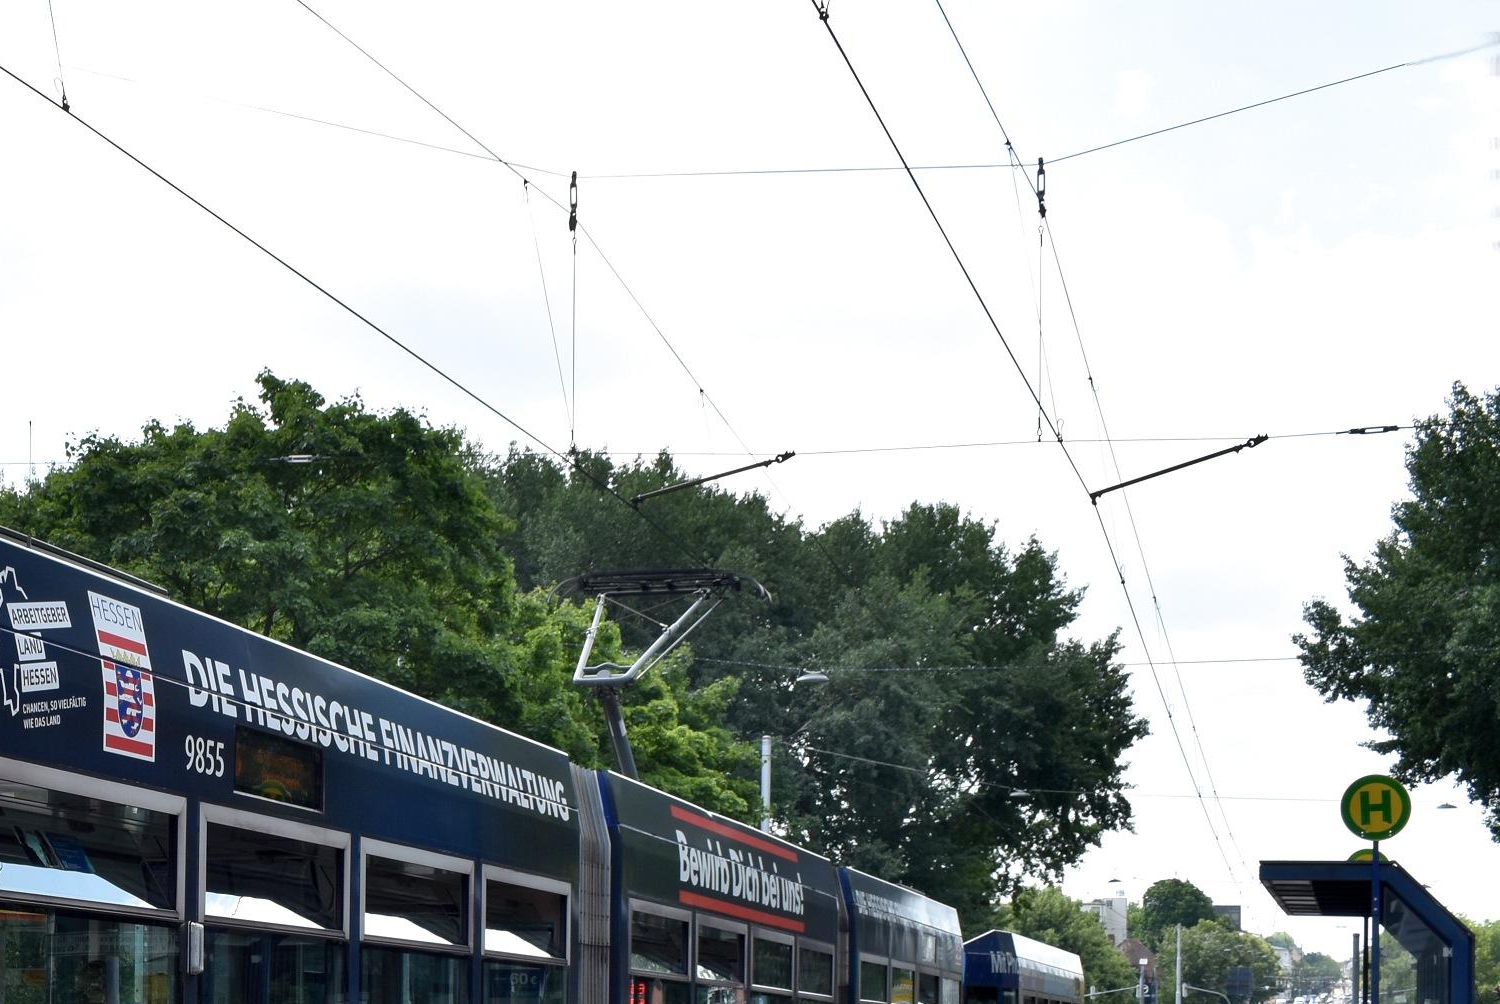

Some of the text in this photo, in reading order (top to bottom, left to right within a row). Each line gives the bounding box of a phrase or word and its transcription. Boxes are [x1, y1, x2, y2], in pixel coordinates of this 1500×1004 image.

[11, 606, 68, 625] ARBEITGEBER
[92, 600, 142, 632] HESSEN
[17, 637, 43, 655] LAND
[23, 667, 57, 687] HESSEN
[22, 696, 87, 715] CHANCEN, SO VIELFÄLTIG
[23, 714, 61, 729] WIE DAS LAND
[182, 650, 237, 718] DIE
[238, 669, 379, 762] HESSISCHE
[378, 718, 570, 822] FINANZVERWALTUNG
[184, 734, 225, 777] 9855
[1360, 790, 1392, 825] H
[676, 829, 804, 916] Bewirb Dich bei uns!
